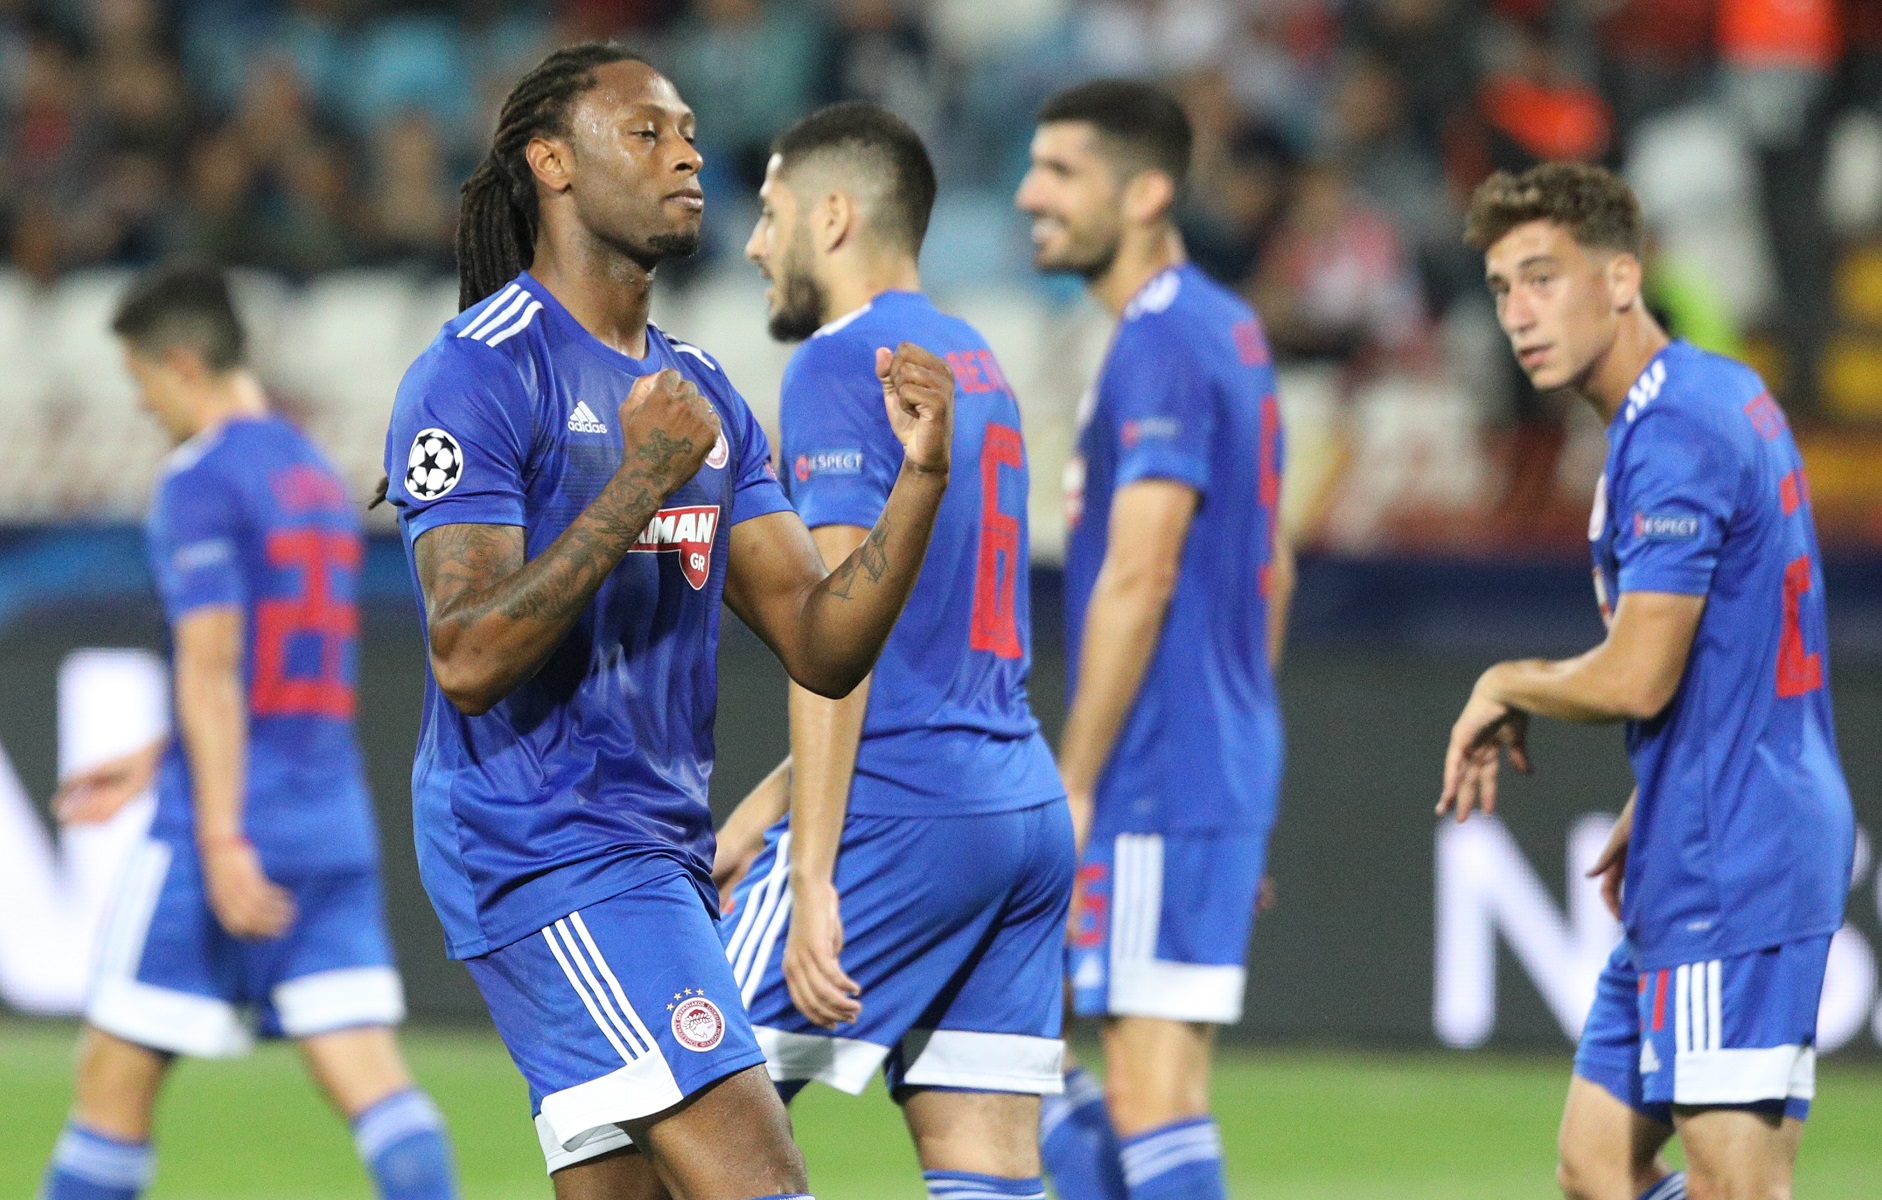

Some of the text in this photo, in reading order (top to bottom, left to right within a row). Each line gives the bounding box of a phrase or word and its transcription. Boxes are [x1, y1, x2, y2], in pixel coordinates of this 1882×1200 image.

[567, 420, 607, 434] adidas
[969, 422, 1024, 659] 6
[690, 552, 706, 573] GR
